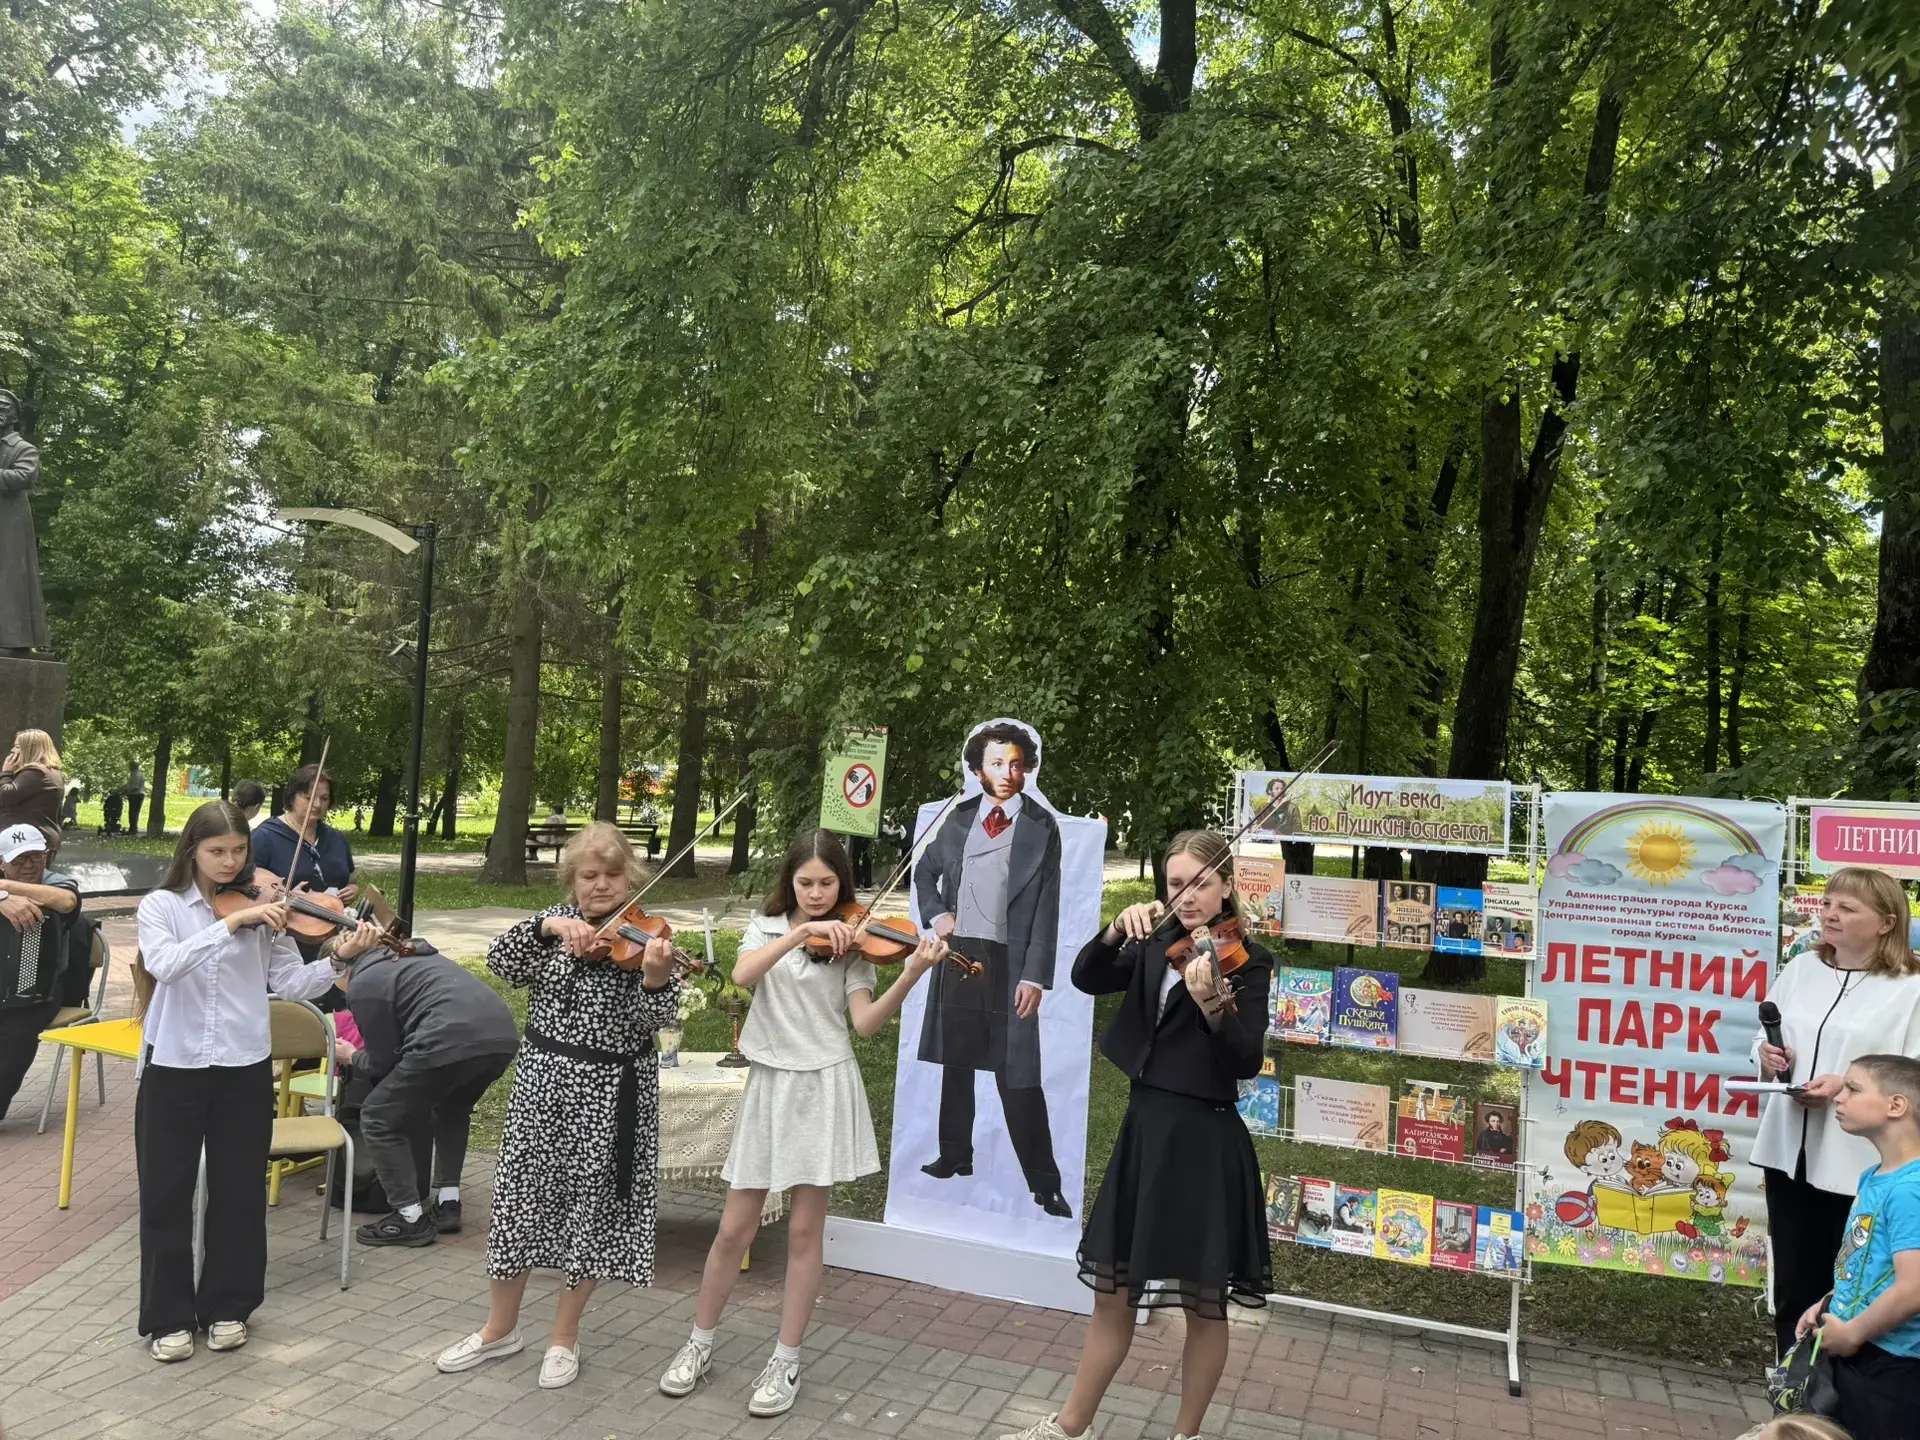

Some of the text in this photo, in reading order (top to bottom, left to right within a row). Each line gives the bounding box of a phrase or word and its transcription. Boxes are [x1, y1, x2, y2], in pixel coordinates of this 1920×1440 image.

[1351, 783, 1445, 812] Идут века,
[12, 831, 27, 843] NY
[1309, 812, 1490, 842] но Пушкин остается
[1834, 826, 1920, 856] ЛЕТНИ
[1236, 881, 1272, 893] РОССИЮ
[1484, 898, 1520, 906] ПИСАТЕЛИ
[1566, 889, 1748, 912] Администрация города Курска
[1548, 899, 1766, 926] Управление культуры города Курска
[1611, 926, 1698, 941] города Курска
[1656, 920, 1706, 931] система
[1709, 923, 1773, 937] библиотек
[1541, 942, 1768, 1003] ЛЕТНИЙ
[1577, 997, 1722, 1055] ПАРК
[1541, 1056, 1760, 1118] ЧТЕНИЯ
[1404, 1129, 1459, 1142] КАПИТАНСКАЯ
[1418, 1137, 1443, 1146] ДОЧКА
